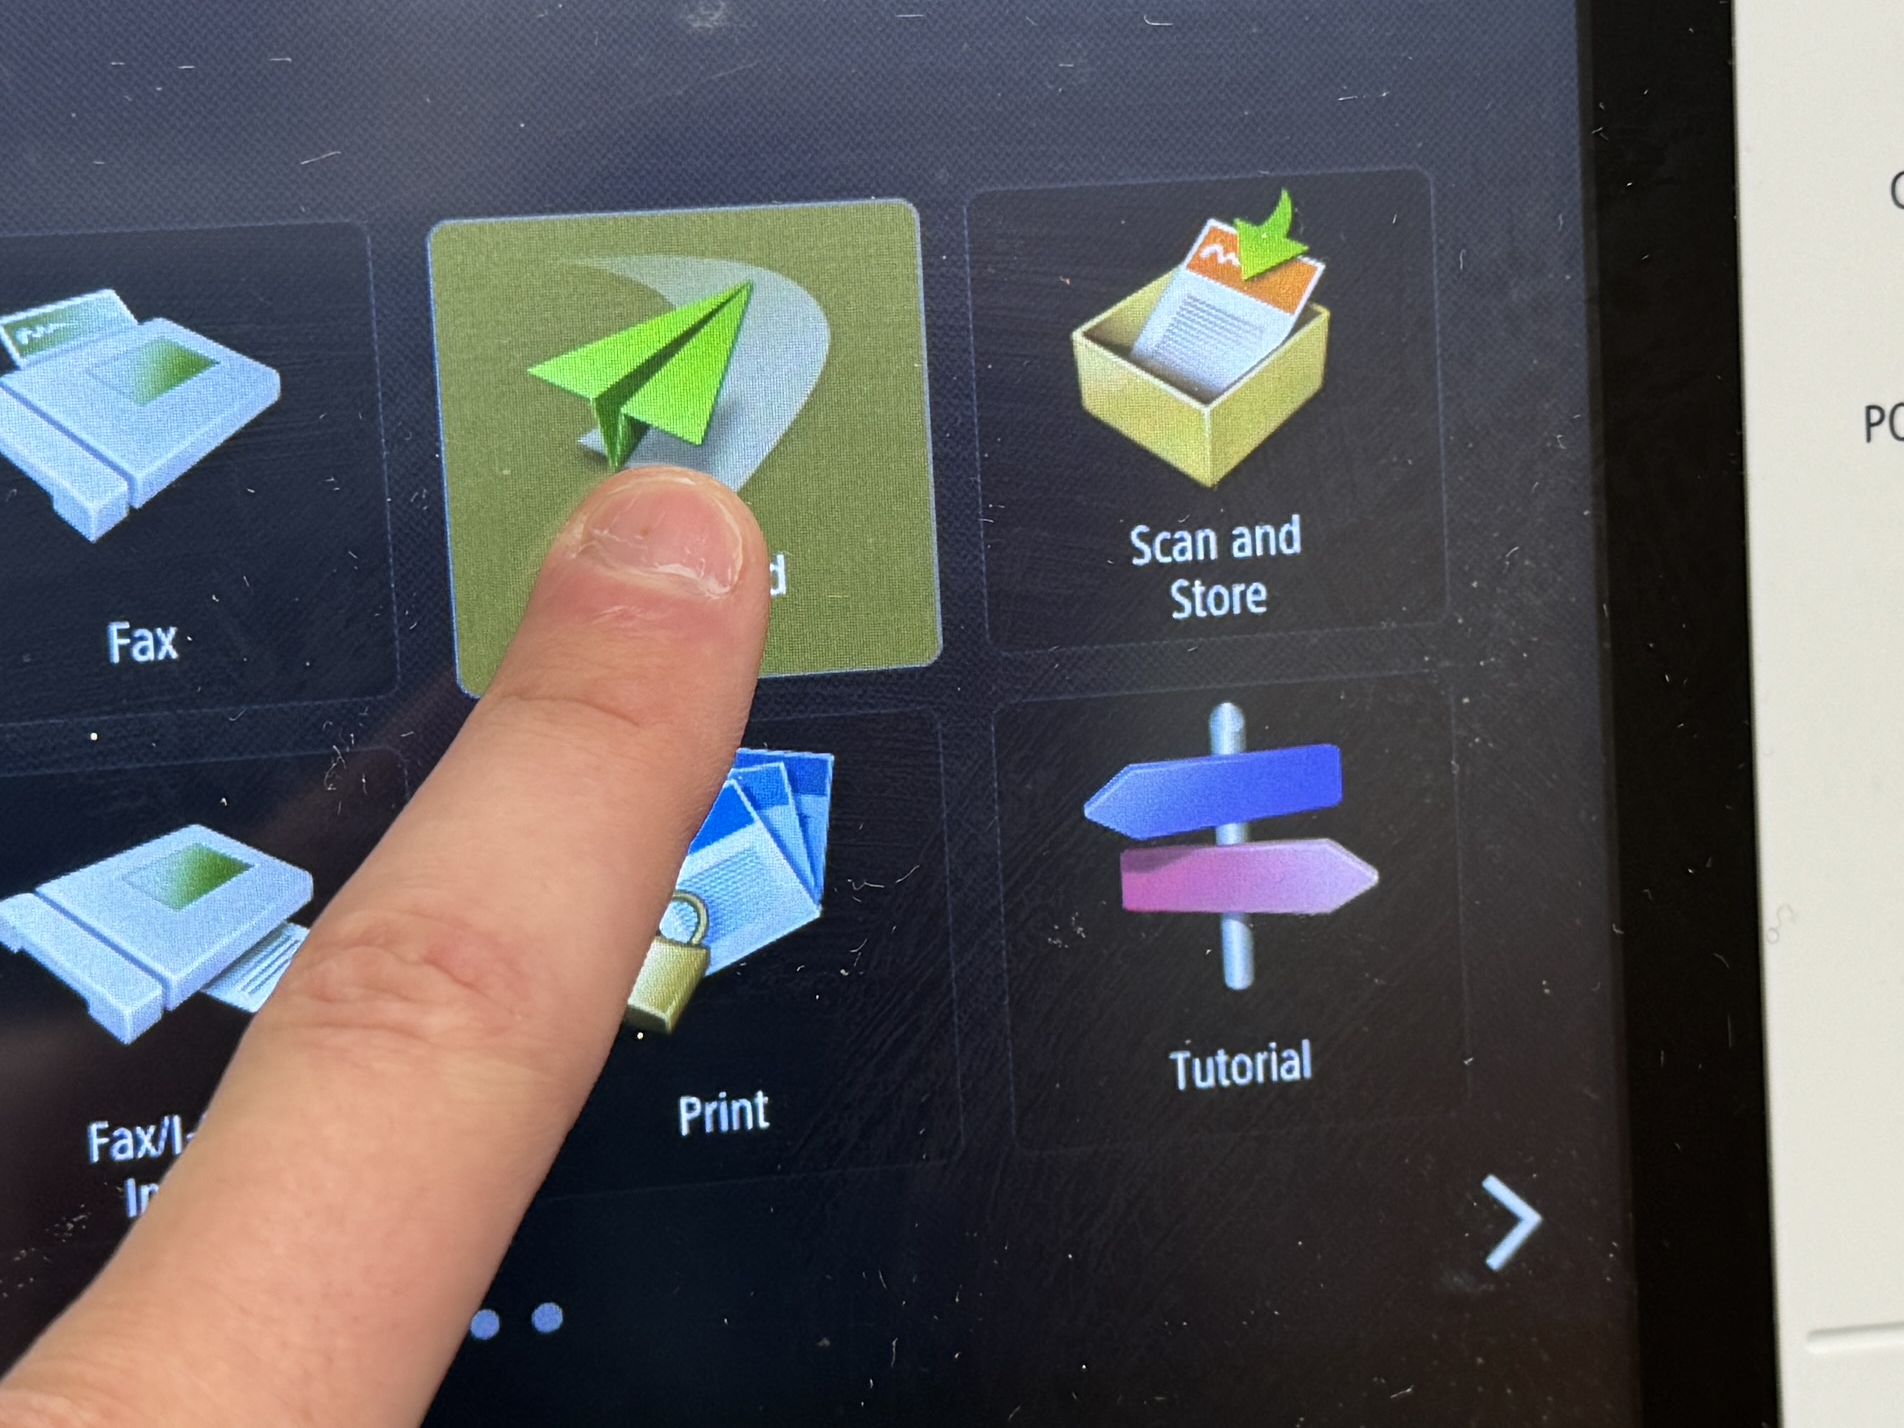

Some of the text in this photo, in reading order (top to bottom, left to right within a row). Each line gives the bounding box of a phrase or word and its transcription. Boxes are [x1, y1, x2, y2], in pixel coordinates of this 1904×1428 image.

[1130, 514, 1302, 567] Scan and
[1170, 577, 1268, 620] Store
[107, 620, 179, 664] Fax
[1169, 1040, 1312, 1091] Tutorial
[678, 1090, 770, 1136] Print
